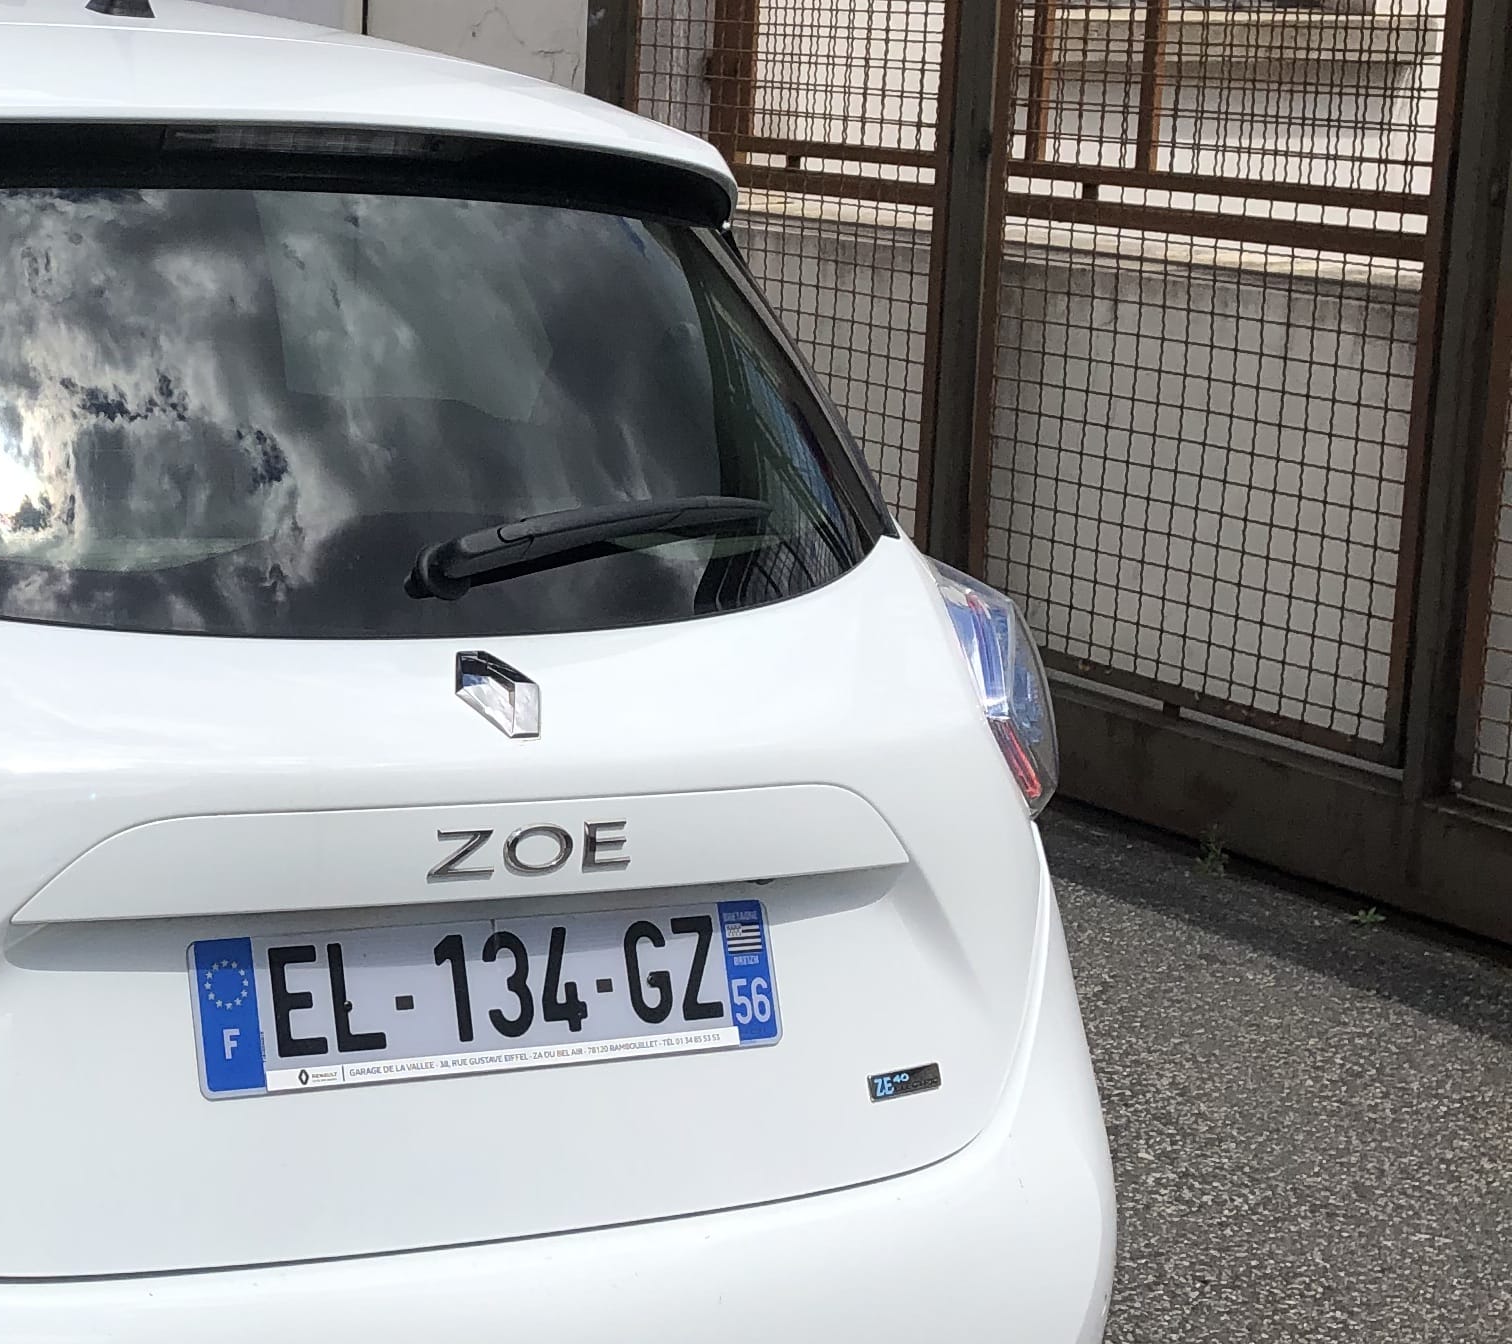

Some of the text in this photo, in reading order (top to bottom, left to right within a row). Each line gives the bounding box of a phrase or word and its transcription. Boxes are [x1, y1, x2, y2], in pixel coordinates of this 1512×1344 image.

[426, 818, 631, 884] ZOE
[731, 977, 771, 1024] 56
[223, 1028, 240, 1060] F
[349, 1066, 382, 1077] GARAGE
[383, 1065, 394, 1074] DE
[395, 1064, 406, 1072] LA
[452, 1058, 468, 1067] RUE
[469, 1055, 503, 1066] GUSTAVE
[504, 1053, 529, 1063] EIFFEL
[533, 1051, 543, 1060] ZA
[544, 1050, 555, 1059] DU
[556, 1048, 570, 1058] BEL
[571, 1047, 583, 1056] AIR
[588, 1045, 609, 1055] 78120
[609, 1039, 658, 1052] RAMBOUILLET
[675, 1037, 684, 1045] 01
[685, 1036, 693, 1044] 34
[703, 1034, 711, 1042] 53
[712, 1033, 720, 1041] 53
